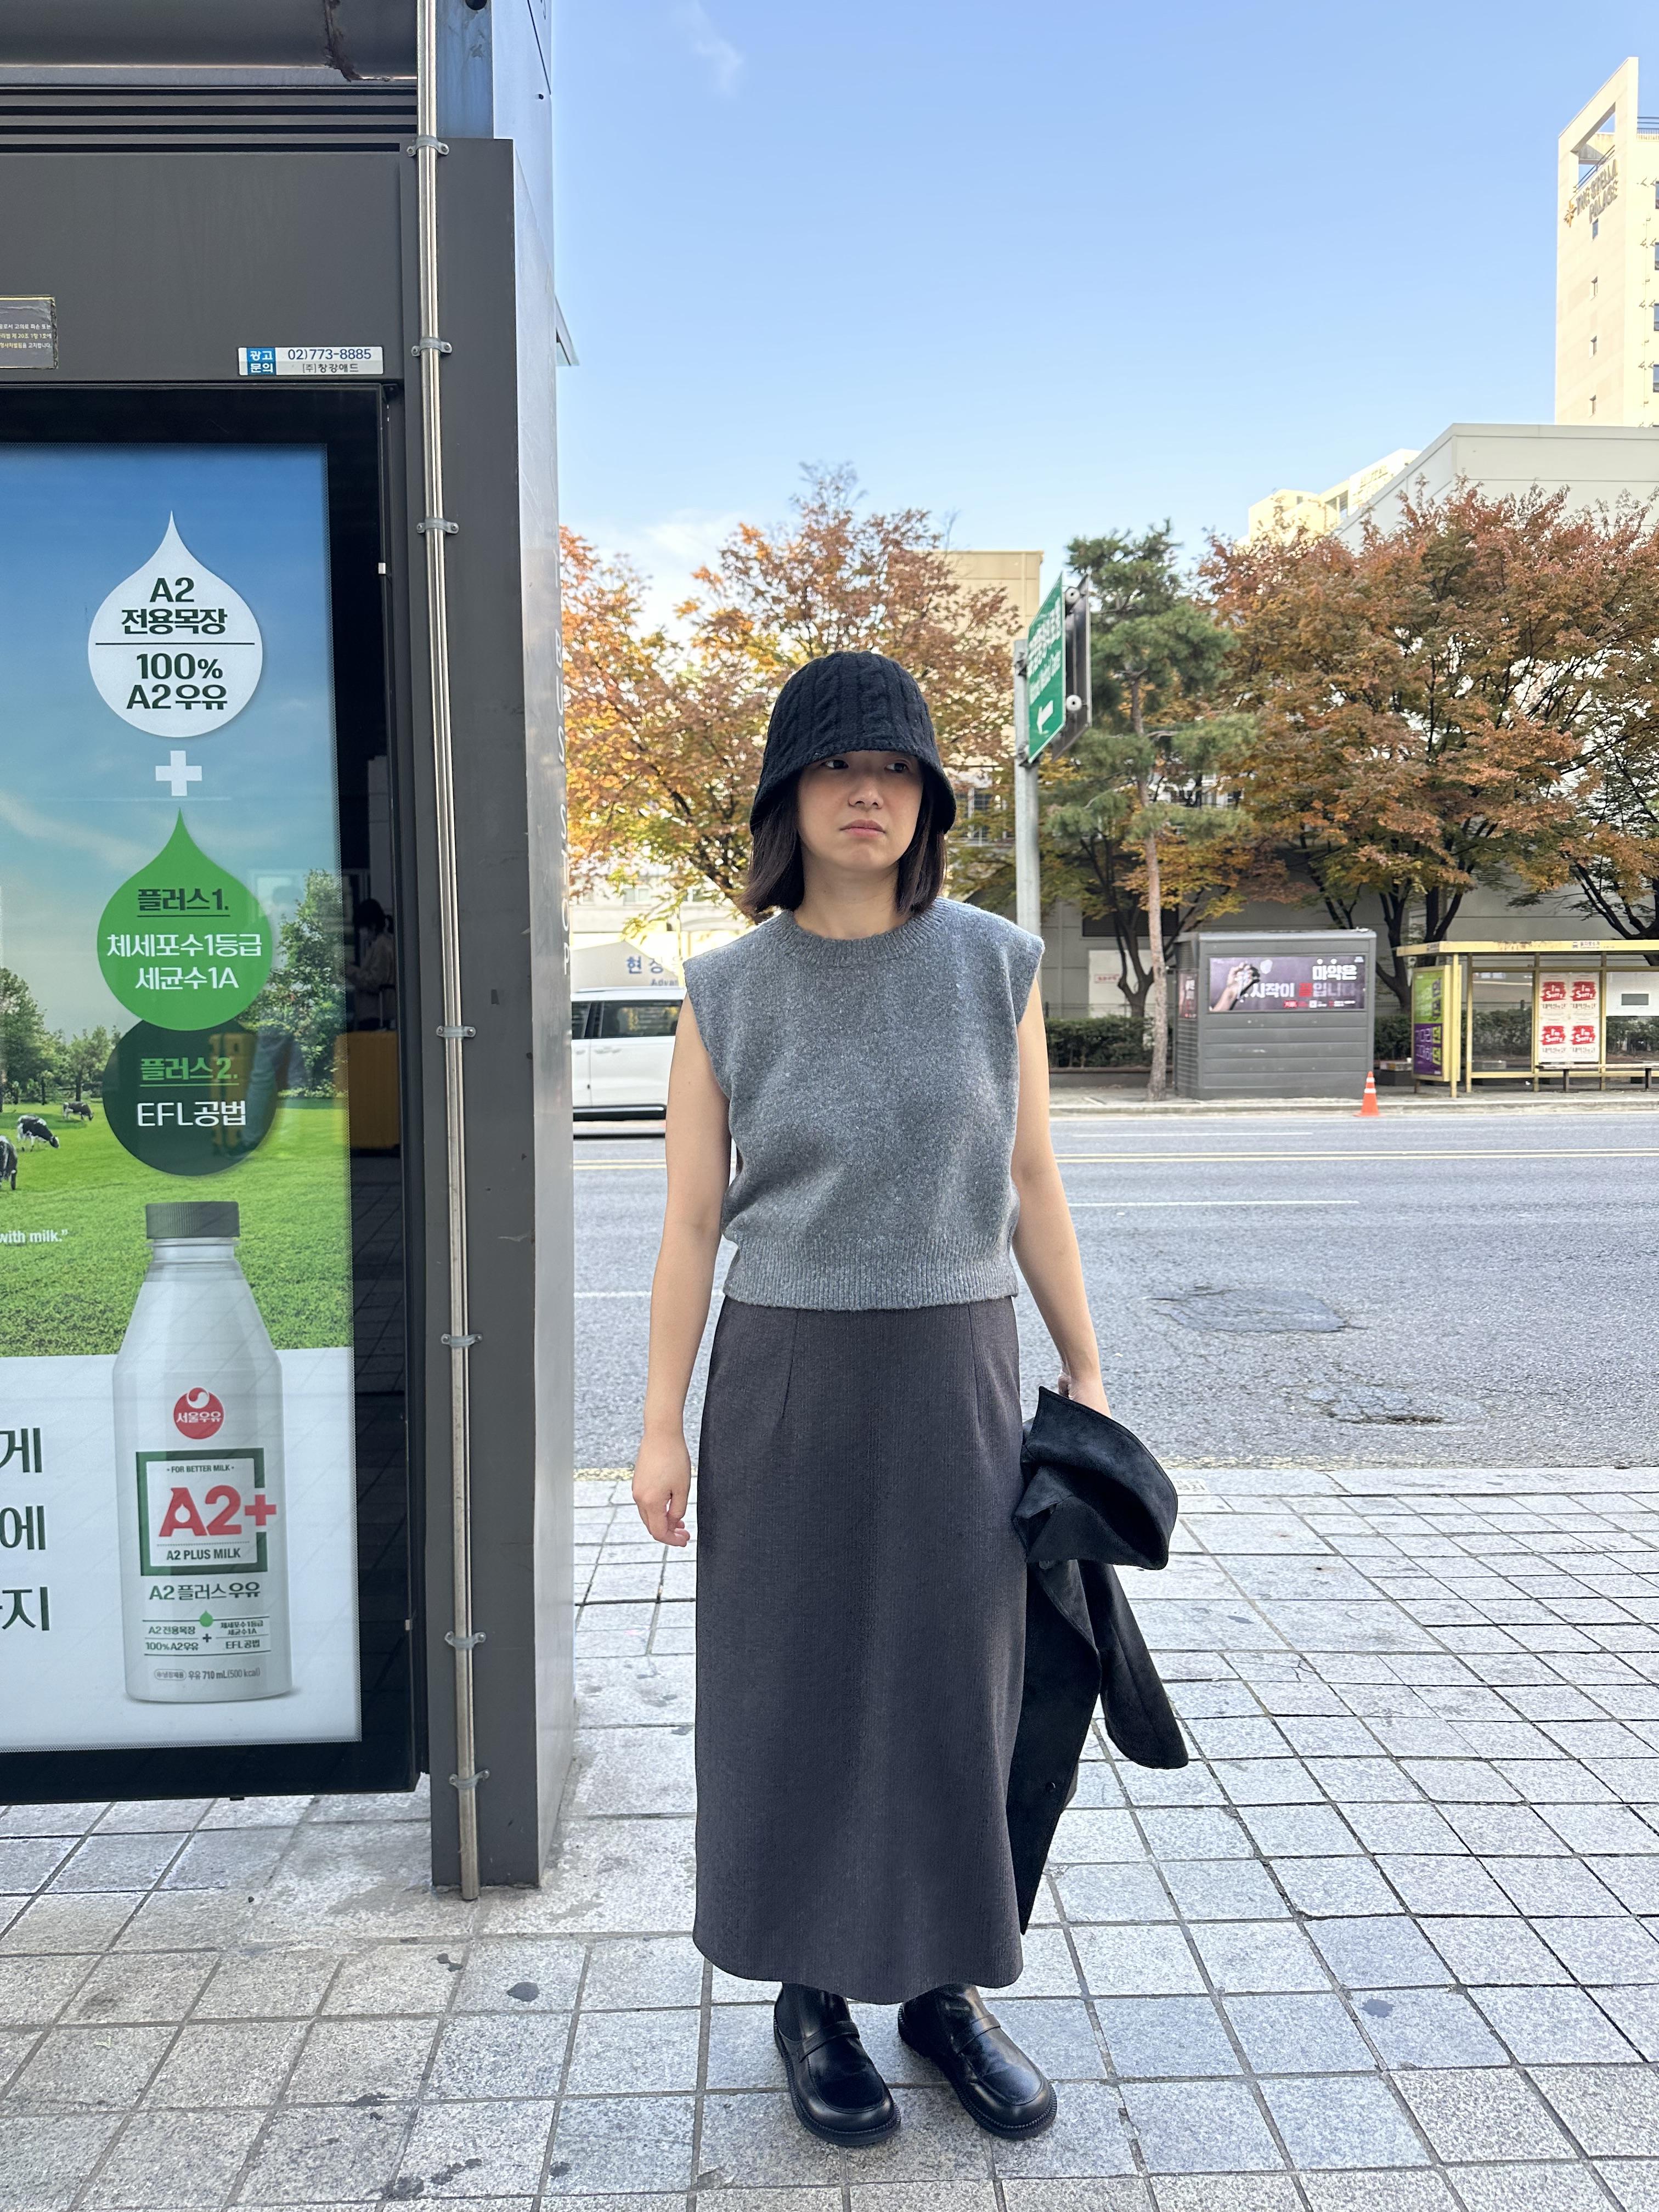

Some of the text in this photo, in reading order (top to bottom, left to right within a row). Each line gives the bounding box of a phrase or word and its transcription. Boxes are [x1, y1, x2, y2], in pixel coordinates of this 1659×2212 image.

[250, 350, 273, 360] 광고
[288, 348, 372, 360] 02)773-8885
[250, 363, 273, 374] 문의
[149, 577, 195, 603] A2
[121, 608, 228, 635] 전용목장
[136, 652, 224, 680] 100%
[137, 888, 229, 912] 플러스1.
[107, 934, 263, 957] 체세포수1등급
[135, 967, 240, 990] 세균수1A
[1312, 964, 1358, 980] 마약은
[1250, 983, 1295, 998] 시작이
[140, 1057, 239, 1081] 플러스2.
[137, 1100, 247, 1127] EFL공법
[176, 1411, 222, 1423] 서울우유
[166, 1548, 241, 1560] A2 PLUS MILK
